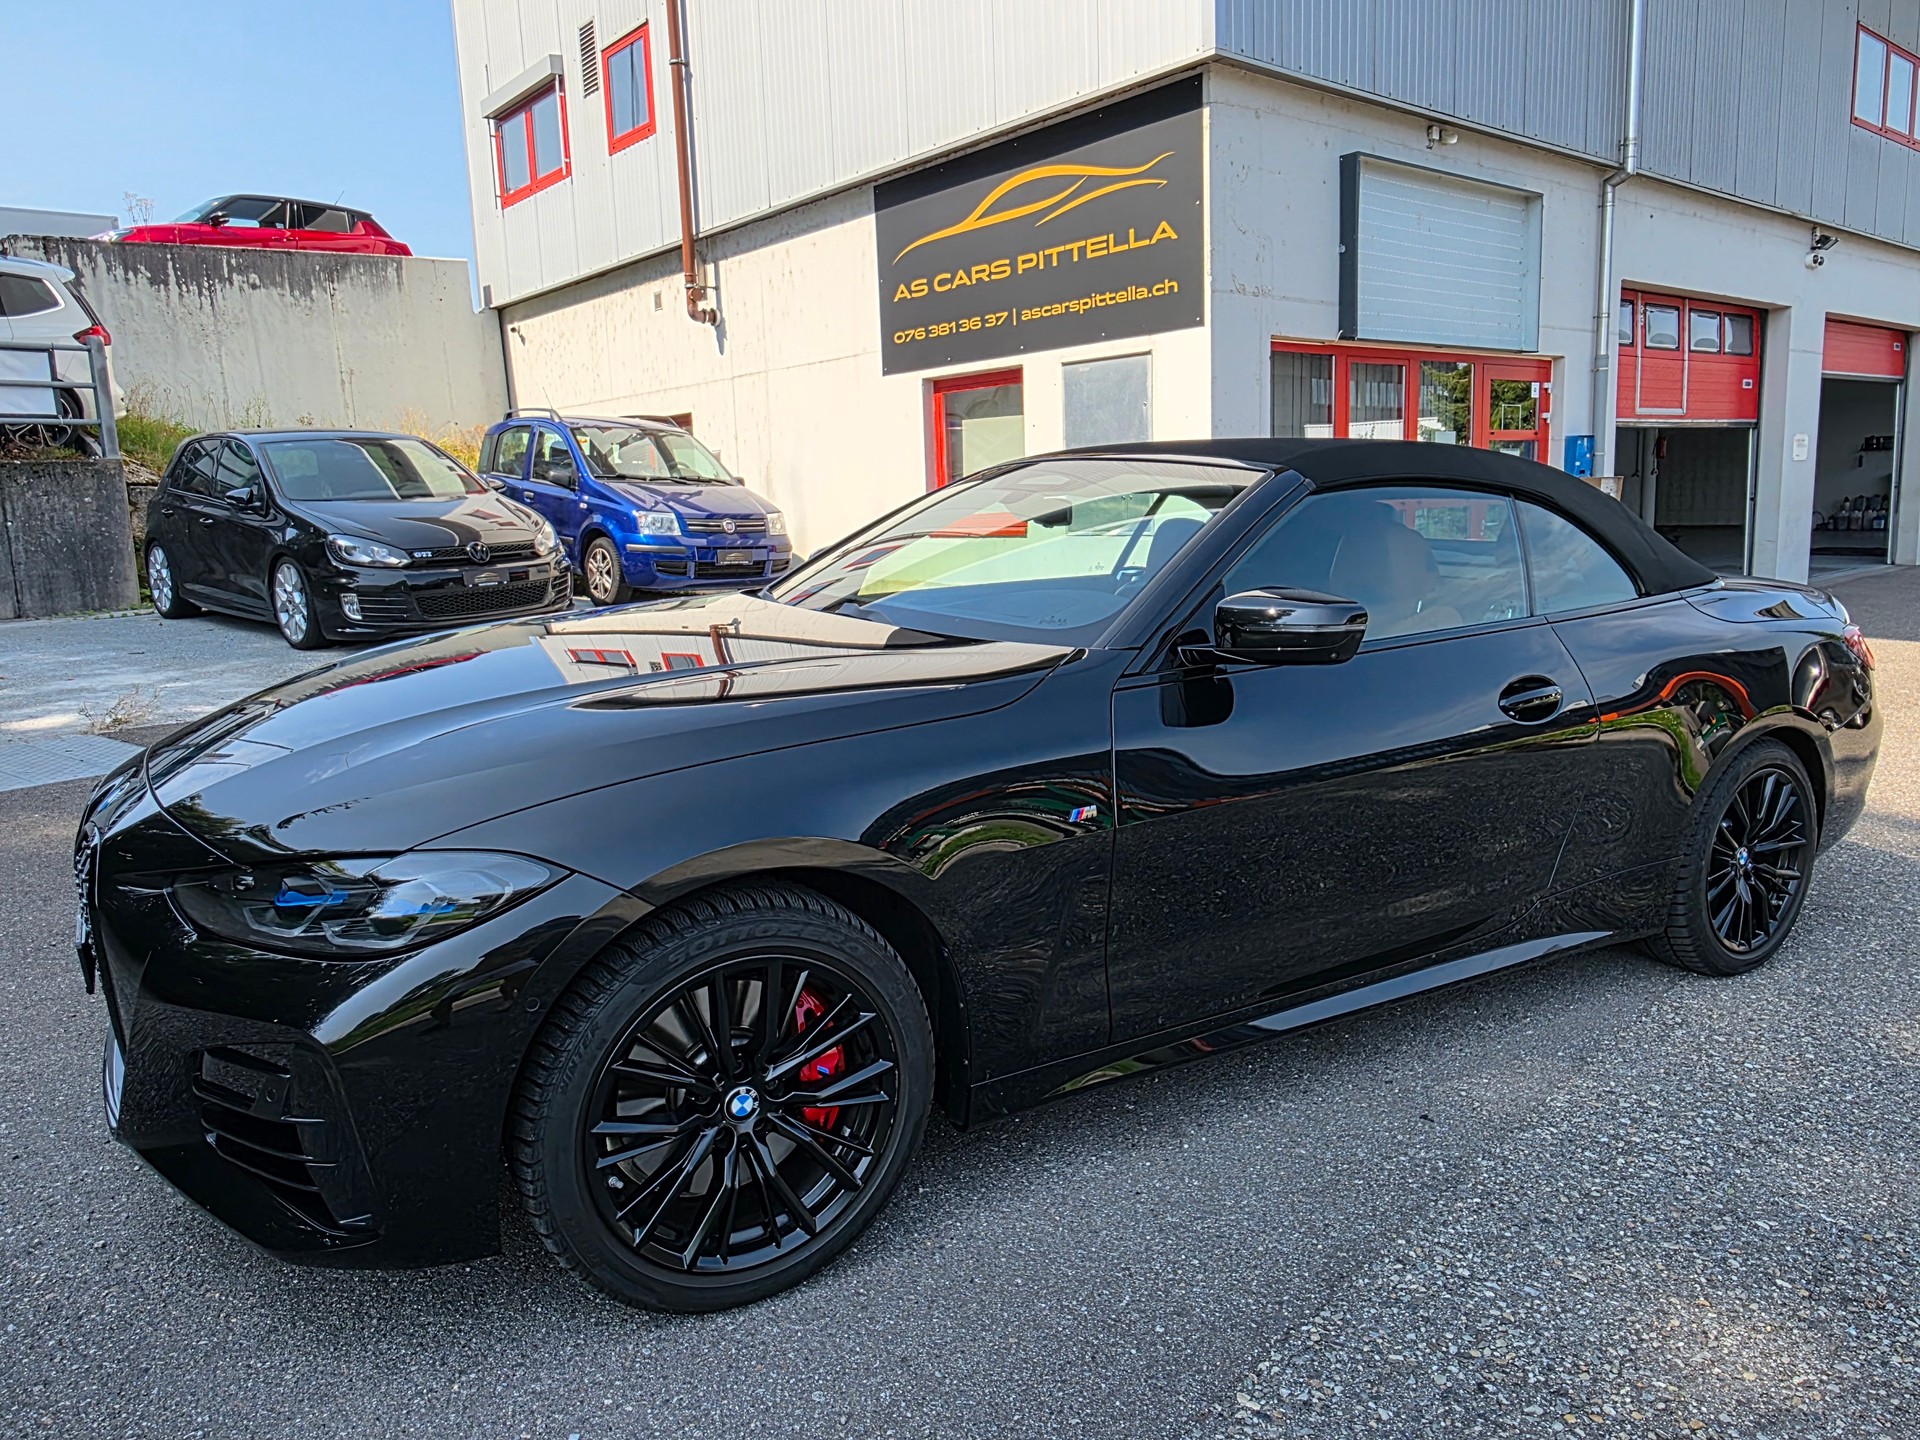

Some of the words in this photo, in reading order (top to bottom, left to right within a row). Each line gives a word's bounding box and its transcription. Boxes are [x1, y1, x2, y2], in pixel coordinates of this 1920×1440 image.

[893, 278, 929, 303] AS
[933, 259, 1011, 292] CARS
[1017, 220, 1178, 274] PITTELLA
[893, 327, 926, 344] 076
[928, 321, 956, 338] 381
[958, 316, 982, 332] 36
[984, 311, 1008, 328] 37
[1021, 278, 1179, 321] ascarspittella.ch
